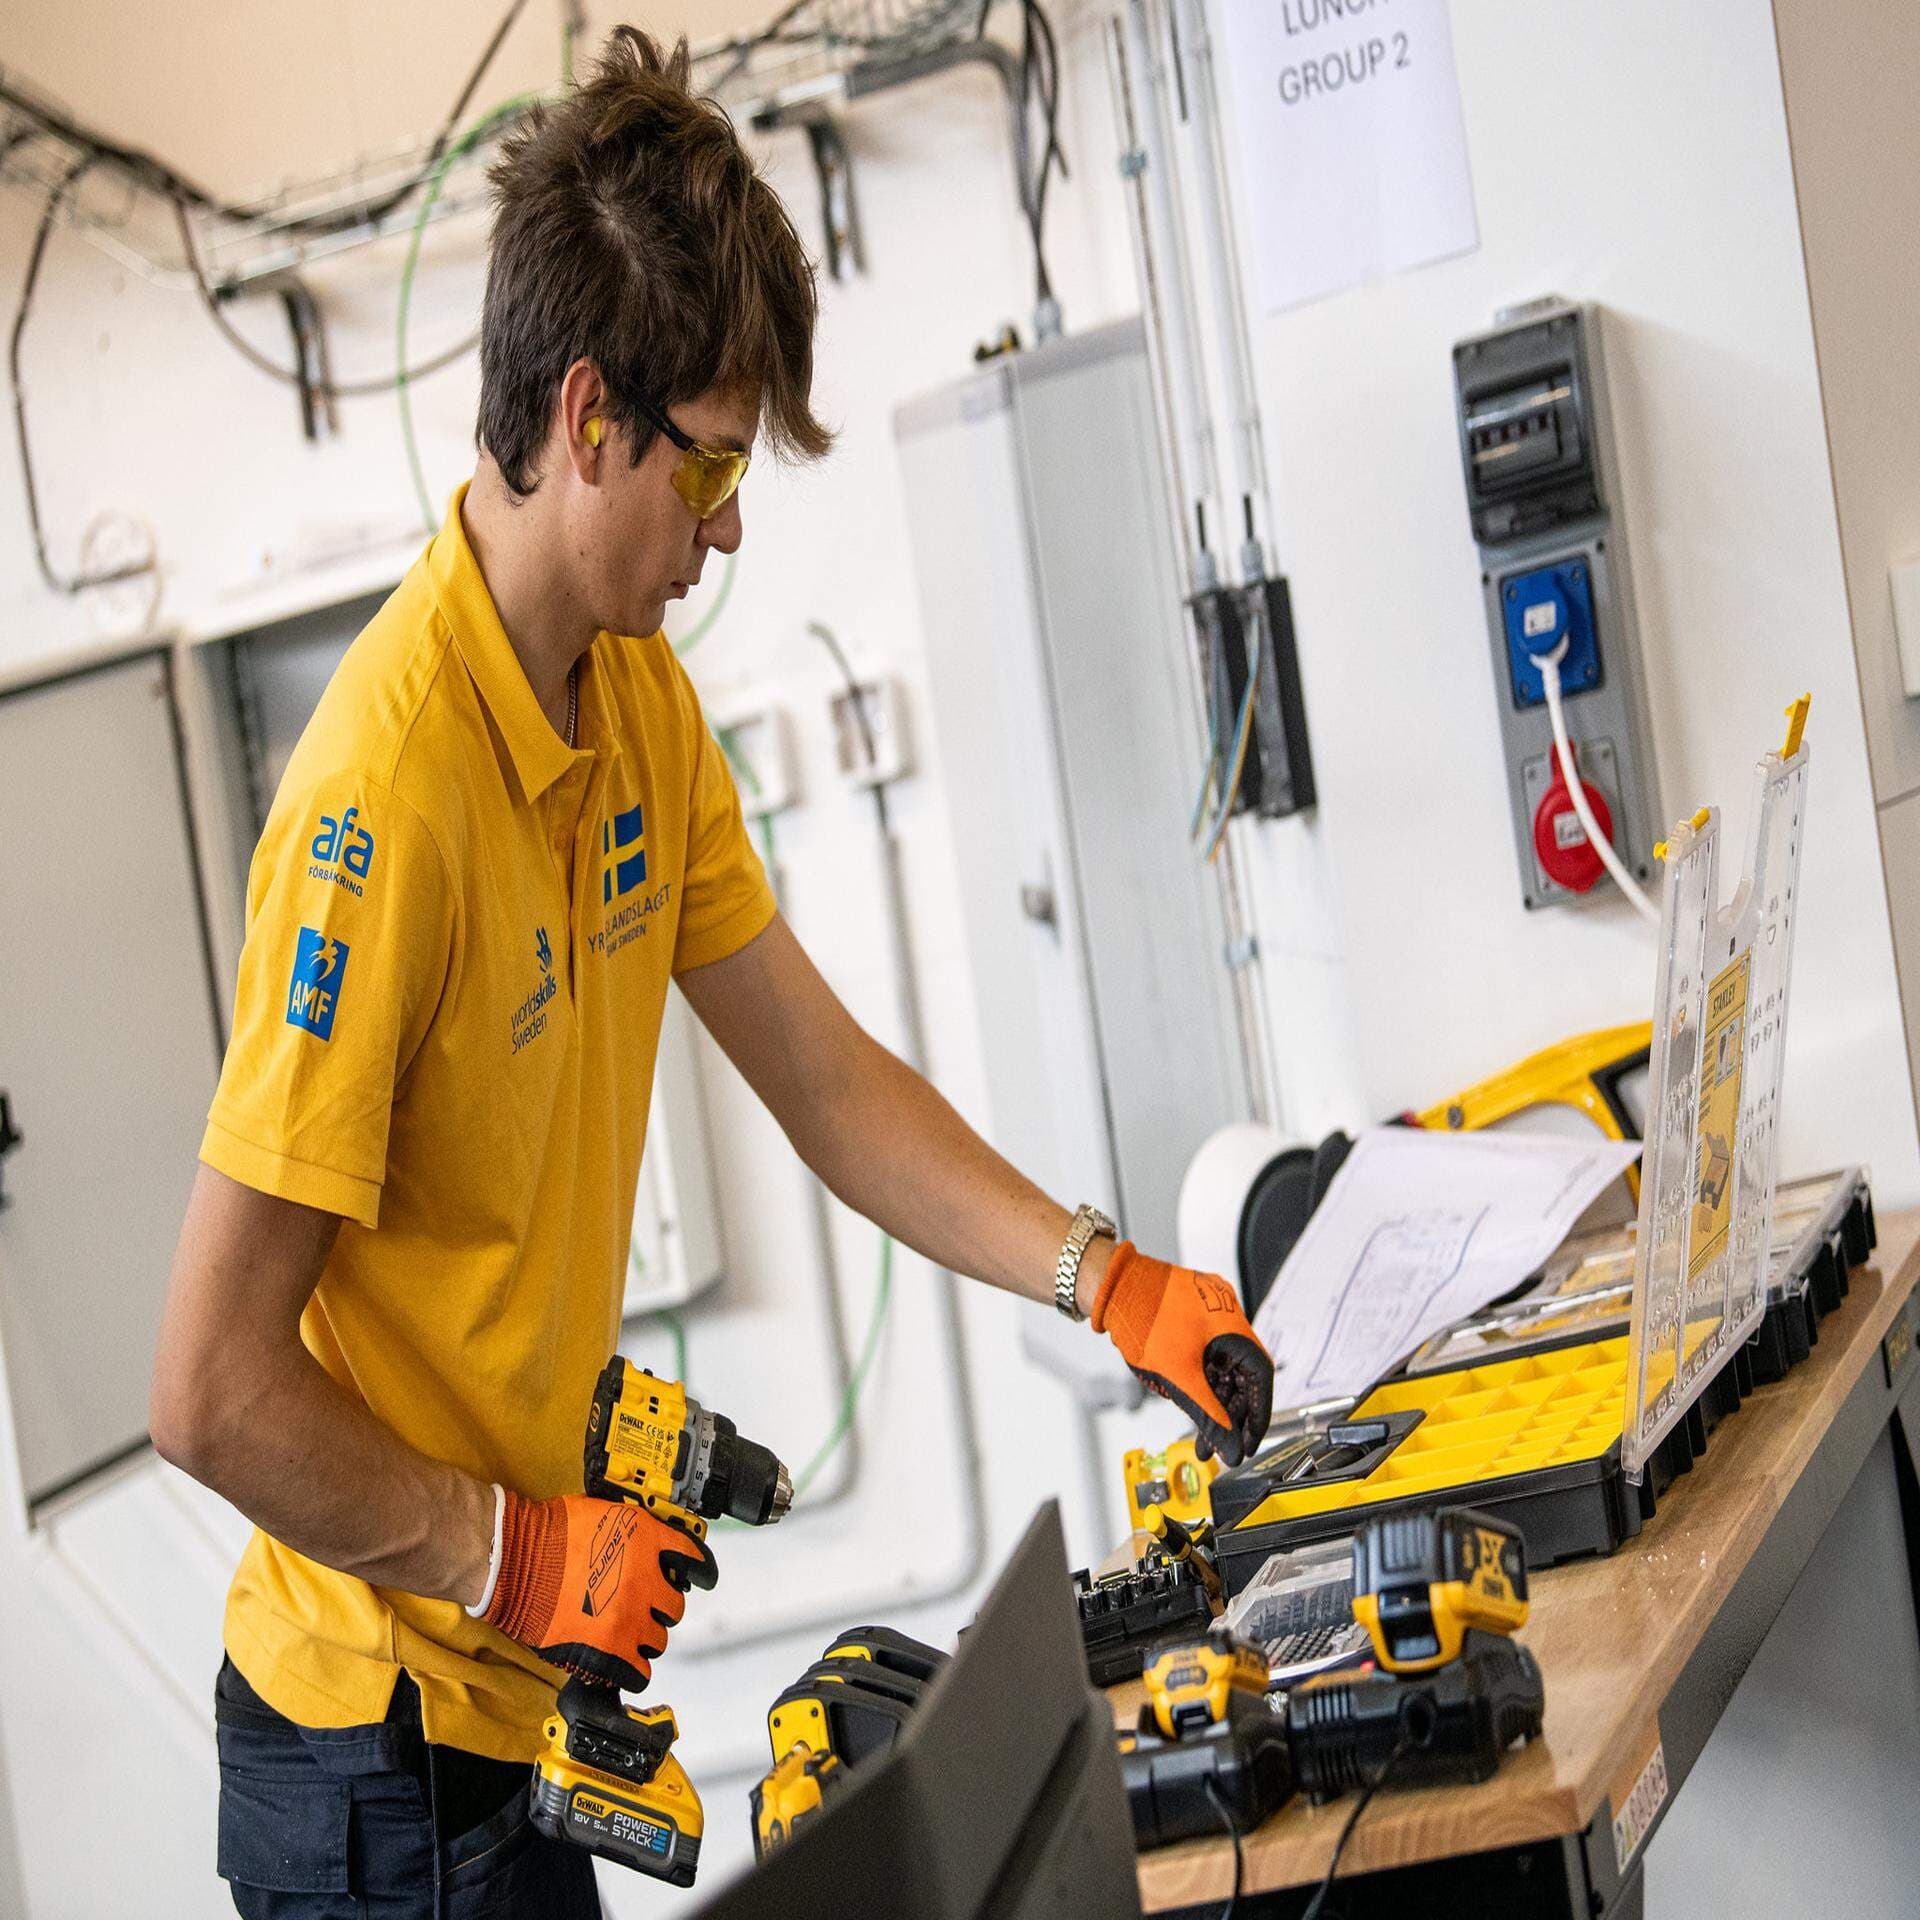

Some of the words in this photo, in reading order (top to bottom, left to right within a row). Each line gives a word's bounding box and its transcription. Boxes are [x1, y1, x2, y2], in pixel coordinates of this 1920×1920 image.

[1281, 0, 1389, 36] LUN
[1279, 37, 1385, 106] GROUP
[1392, 30, 1410, 69] 2
[311, 806, 375, 879] afa
[308, 865, 364, 898] FÖRSÄKRING
[290, 979, 332, 1024] AMF
[511, 973, 557, 1031] worldskills
[1712, 980, 1736, 1019] STANLEY
[511, 1012, 548, 1056] Sweden
[588, 1526, 623, 1590] GUIDE
[574, 1811, 590, 1825] 18V
[611, 1824, 652, 1849] STACK
[614, 1812, 658, 1837] POWER
